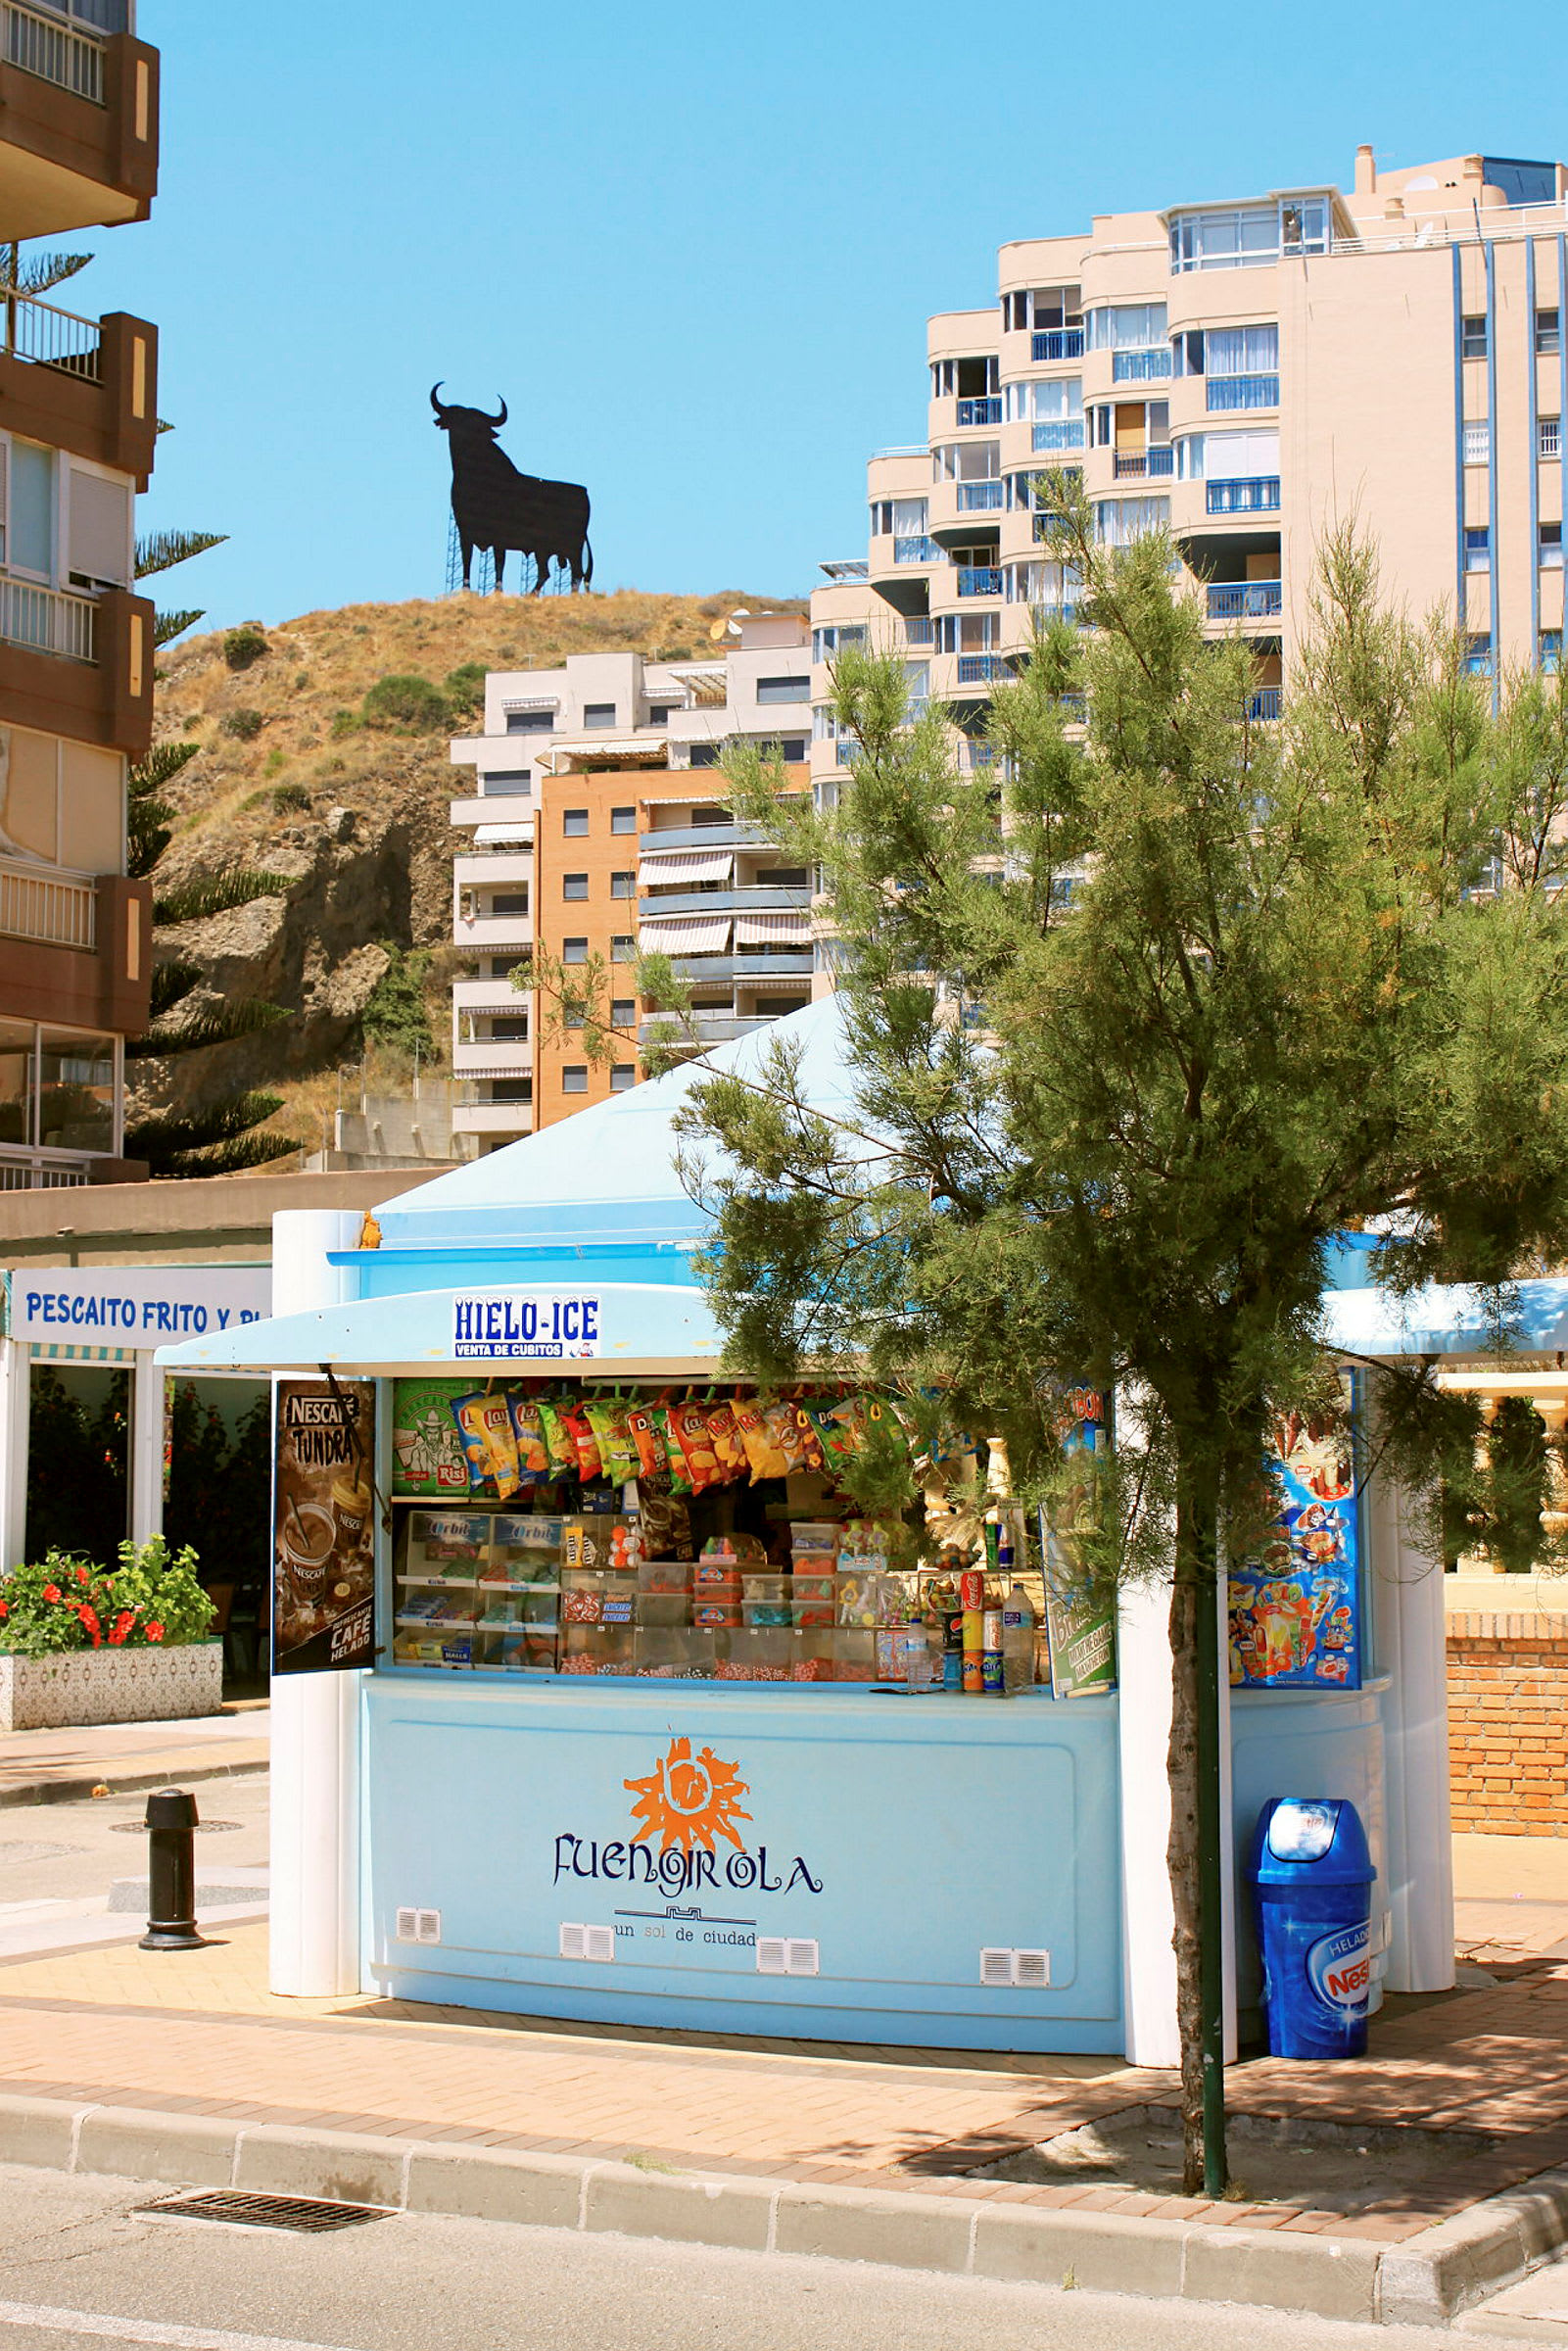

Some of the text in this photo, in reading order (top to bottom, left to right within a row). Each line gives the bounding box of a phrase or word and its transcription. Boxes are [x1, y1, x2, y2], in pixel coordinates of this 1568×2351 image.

[26, 1292, 136, 1328] PESCAITO
[143, 1302, 207, 1333] FRITO
[216, 1309, 231, 1330] Y
[454, 1296, 598, 1341] HIELO-ICE
[456, 1344, 562, 1357] VENTA DE CUBITOS
[291, 1397, 355, 1423] NESCAÉ
[292, 1429, 354, 1466] TUNDRA
[430, 1520, 470, 1536] Orbit
[512, 1525, 552, 1539] Orbit
[330, 1633, 370, 1662] HELADO
[614, 1924, 756, 1946] un sol de ciudad
[1327, 1960, 1369, 1996] Nes
